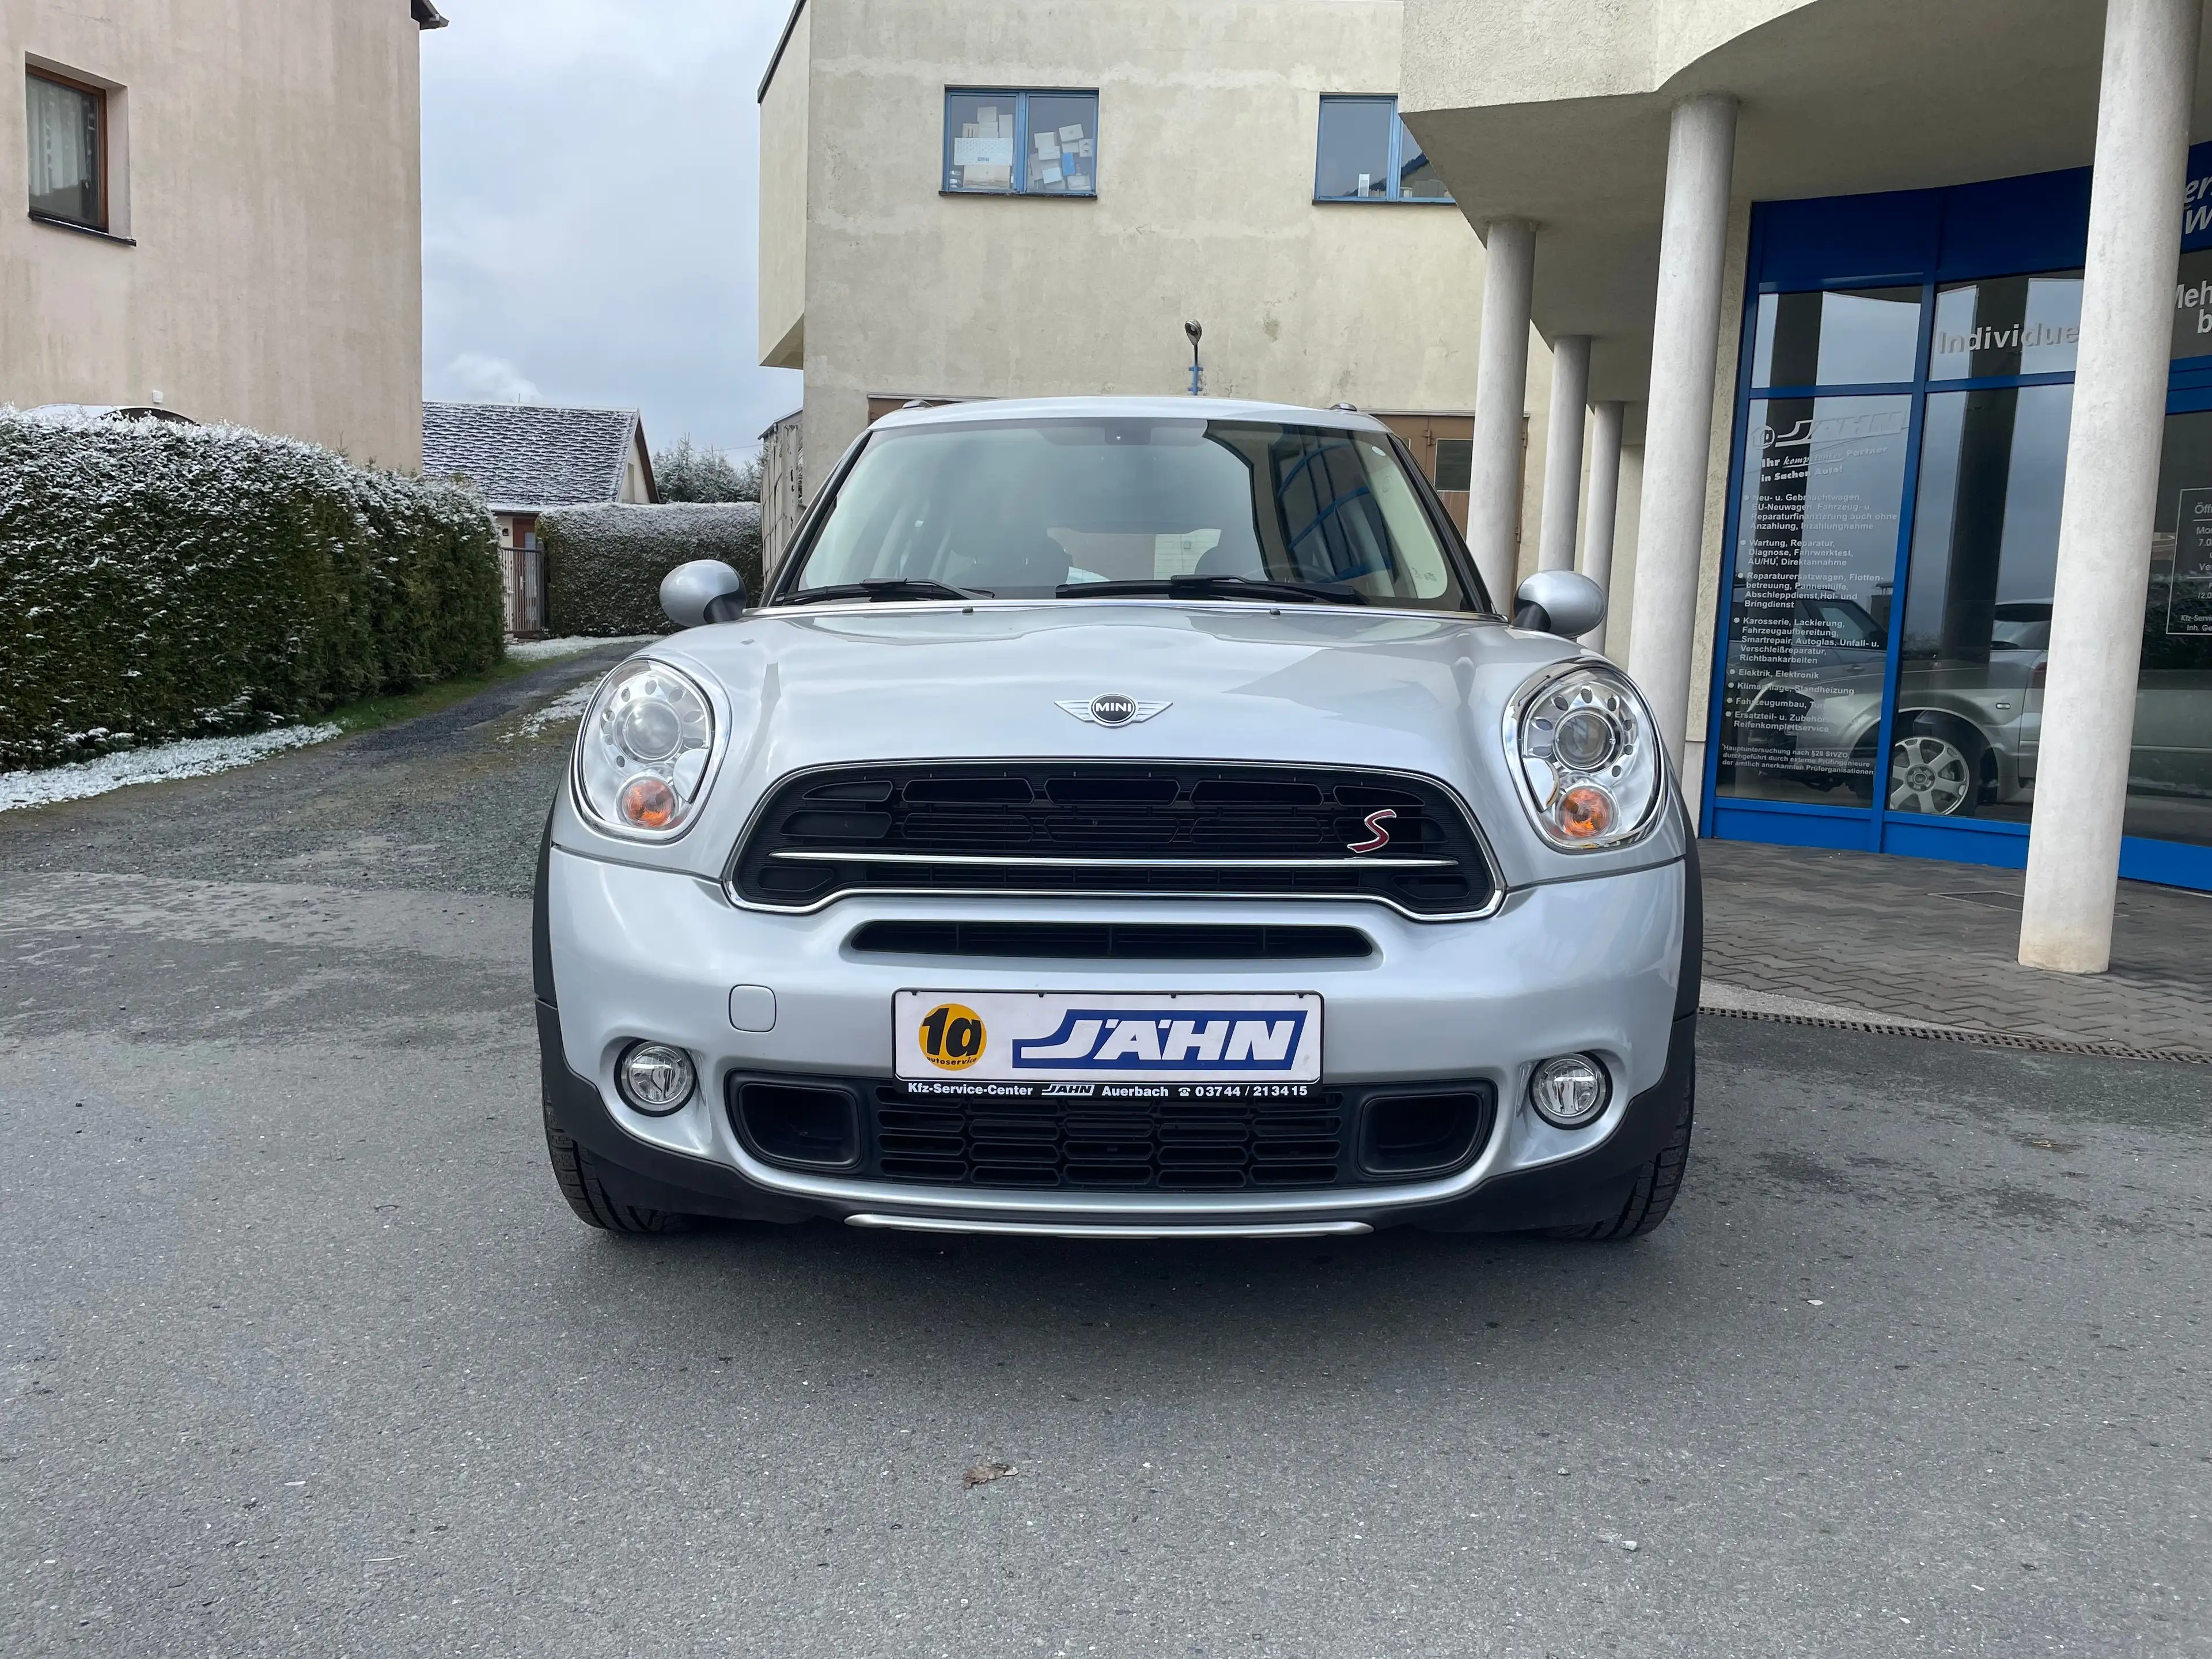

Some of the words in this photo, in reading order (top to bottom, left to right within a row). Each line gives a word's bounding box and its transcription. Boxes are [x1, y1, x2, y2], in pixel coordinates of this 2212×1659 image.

[1762, 457, 1780, 468] Ihr
[1783, 453, 1843, 465] komptenter
[1846, 446, 1889, 457] Partner
[1762, 474, 1771, 482] in
[1774, 470, 1811, 480] Sachen
[1814, 465, 1843, 476] Auto!
[1817, 503, 1862, 512] Fahrzeug-
[1751, 513, 1848, 521] Reparaturfinanzierung
[1750, 522, 1798, 531] Anzahlung,
[1749, 539, 1788, 548] Wartung,
[1790, 539, 1835, 548] Reparatur,
[1749, 548, 1791, 558] Diagnose,
[1794, 549, 1854, 557] Fahrwerktest,
[1747, 572, 1847, 582] Reparaturersatzwagen,
[1849, 573, 1884, 581] Flotten-
[1746, 582, 1793, 591] betreuung,
[1794, 582, 1849, 590] Pannenhilfe,
[1744, 600, 1794, 609] Bringdienst
[1743, 617, 1791, 626] Karosserie,
[1794, 619, 1845, 628] Lackierung,
[1742, 626, 1839, 637] Fahrzeugaufbereitung,
[1741, 635, 1793, 645] Smartrepair,
[1795, 638, 1837, 647] Autoglas,
[1839, 639, 1869, 647] Unfall-
[1740, 645, 1827, 656] Verschleißreparatur,
[1740, 654, 1818, 664] Richtbankarbeiten
[1738, 668, 1773, 677] Elektrik,
[1775, 671, 1819, 679] Elektronik
[1794, 685, 1855, 695] Standheizung
[1096, 702, 1132, 712] MINI
[1734, 711, 1777, 720] Ersatzteil-
[1734, 720, 1829, 732] Reifenkomplettservice
[1723, 752, 1767, 760] durchgeführt
[1818, 757, 1870, 767] Prüfingenieure
[1761, 762, 1804, 771] anerkannten
[1806, 764, 1873, 775] Prüforganisationen
[1347, 808, 1397, 854] S
[926, 1056, 978, 1066] autoservice
[908, 1082, 1033, 1096] Kfz-Service-Center
[1101, 1085, 1169, 1096] Auerbach
[1195, 1086, 1241, 1096] 03744
